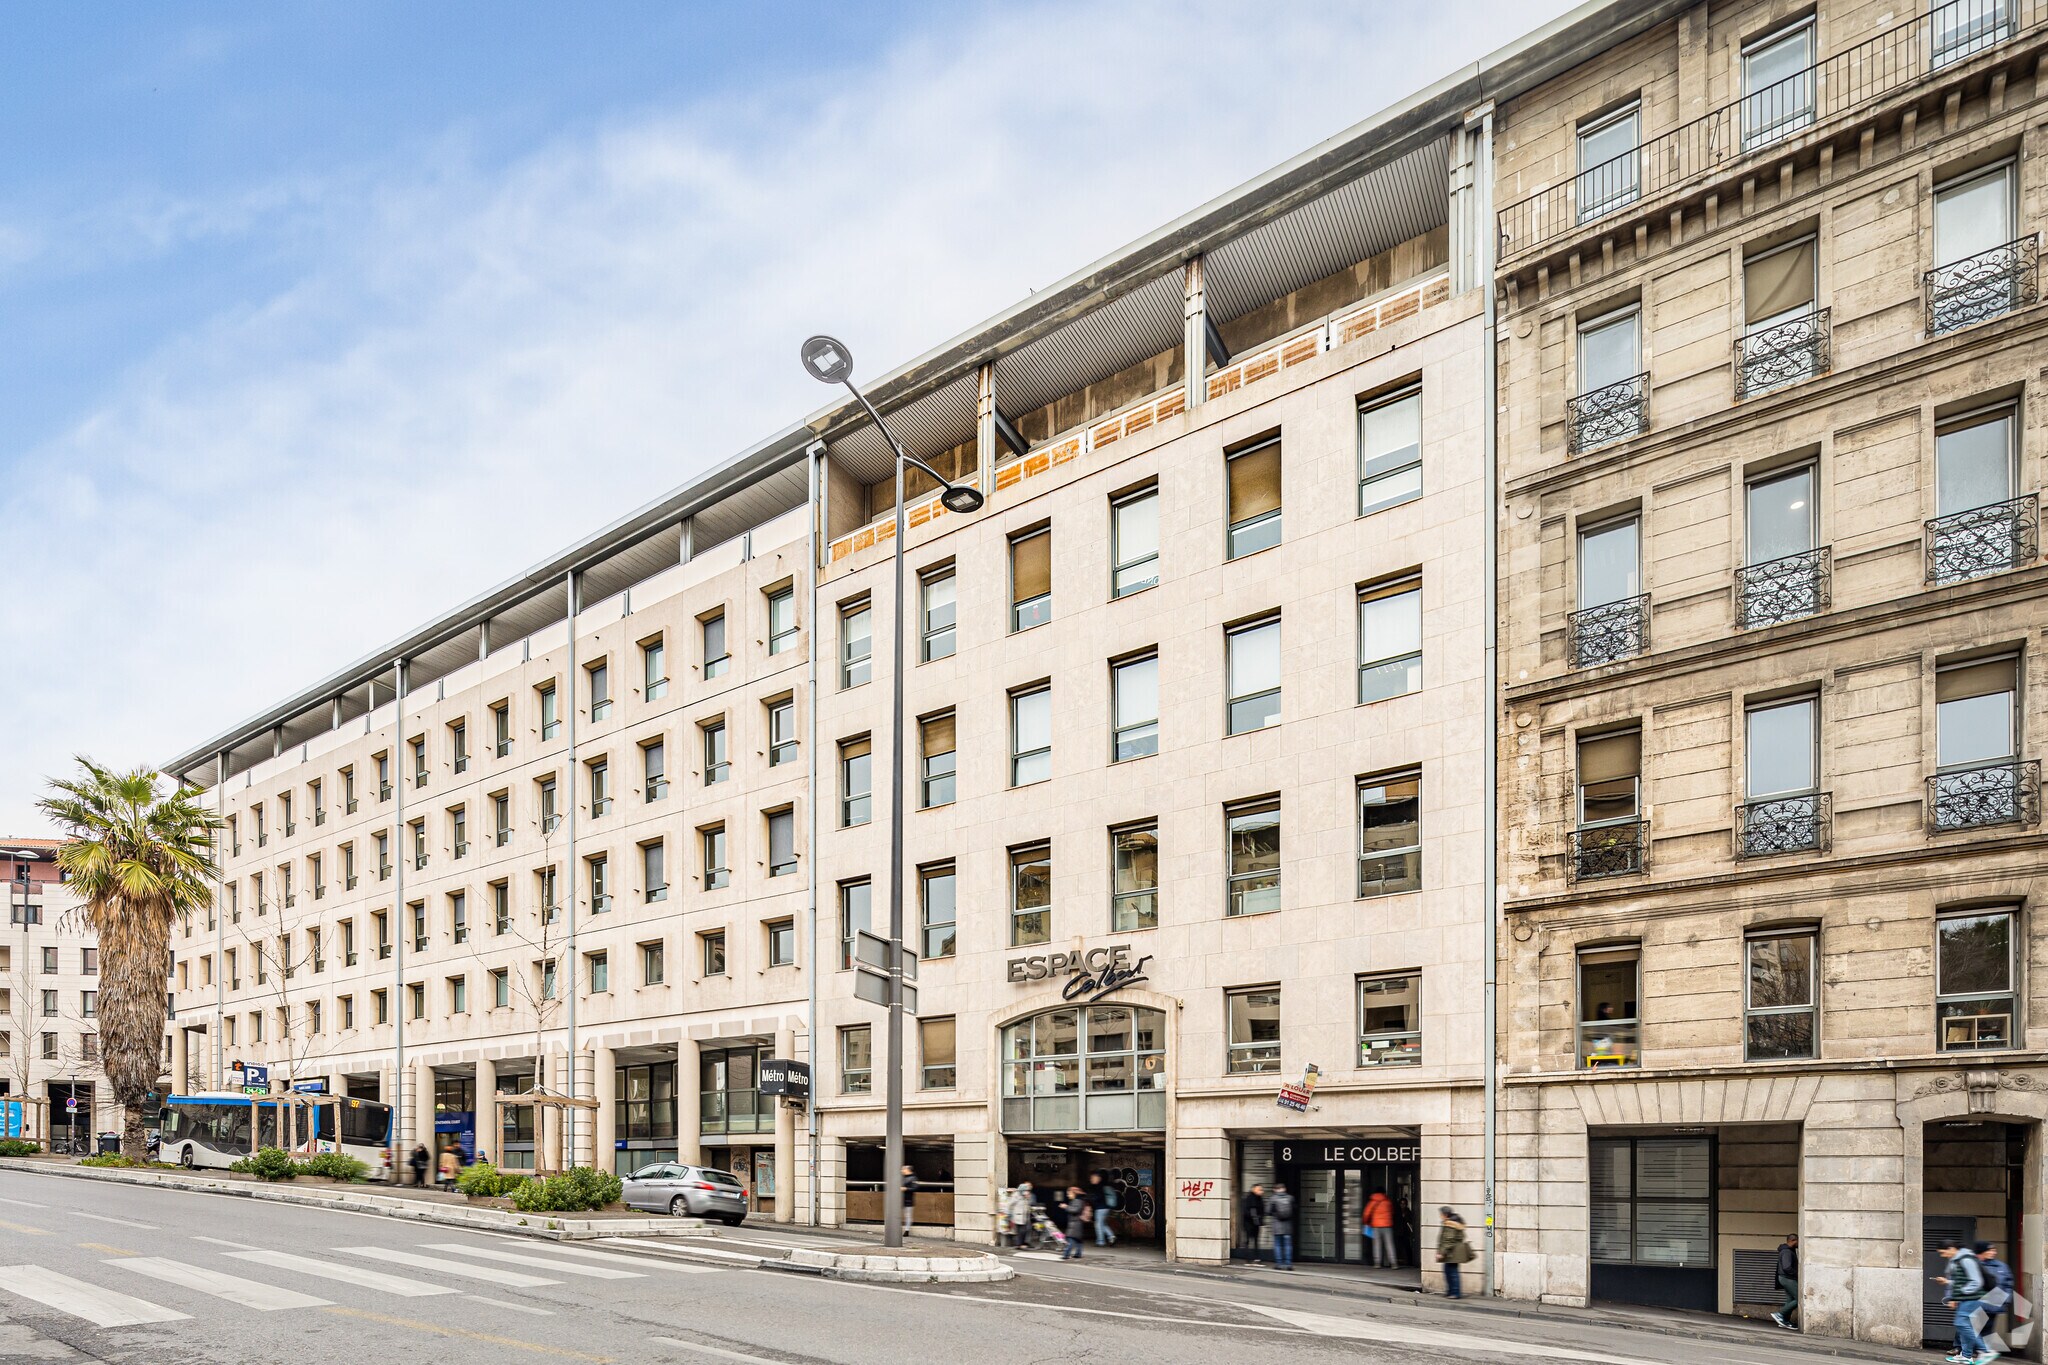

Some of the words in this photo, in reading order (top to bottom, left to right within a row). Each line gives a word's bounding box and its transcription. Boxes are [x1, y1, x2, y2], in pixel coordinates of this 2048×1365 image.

[1007, 944, 1131, 982] ESPACE
[246, 1067, 260, 1082] P
[761, 1069, 785, 1082] Métro
[787, 1070, 809, 1086] Métro
[351, 1099, 360, 1108] 97
[1282, 1147, 1292, 1161] 8
[1324, 1147, 1345, 1161] LE
[1350, 1146, 1421, 1162] COLBER
